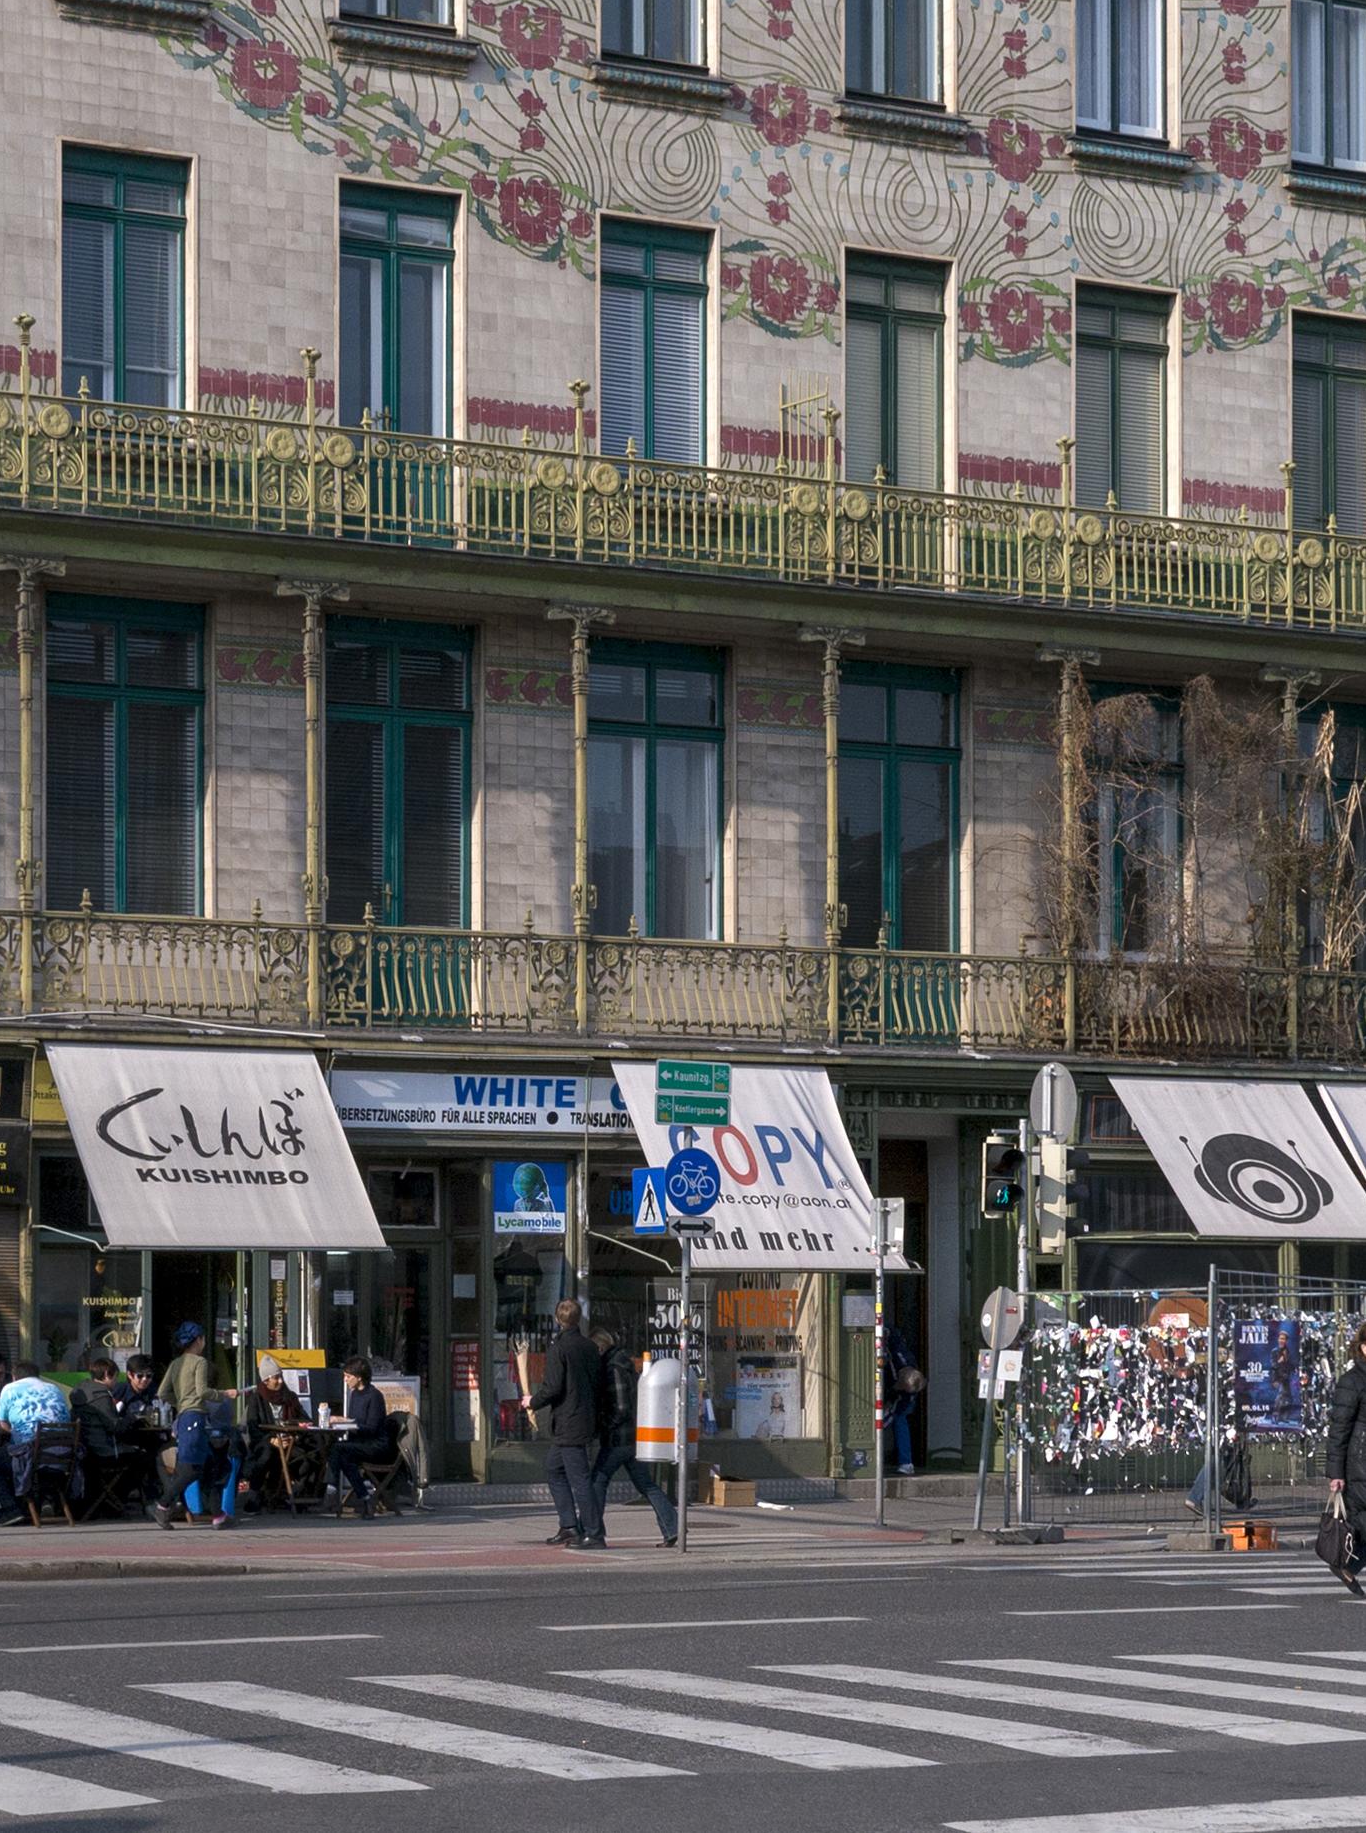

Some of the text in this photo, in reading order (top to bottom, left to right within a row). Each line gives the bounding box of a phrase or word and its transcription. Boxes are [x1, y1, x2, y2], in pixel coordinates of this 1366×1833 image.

[453, 1076, 577, 1108] WHITE
[441, 1107, 460, 1123] FÜR
[462, 1110, 485, 1123] ALLE
[487, 1111, 536, 1125] SPRACHEN
[135, 1167, 309, 1185] KUISHIMBO
[498, 1216, 562, 1228] Lycamobile
[758, 1228, 834, 1252] mehr
[82, 1296, 136, 1306] KUISHIMBO
[717, 1290, 799, 1328] INTERNET
[275, 1280, 285, 1350] panisch Essen
[1239, 1333, 1269, 1345] JALE
[1247, 1361, 1262, 1372] 30
